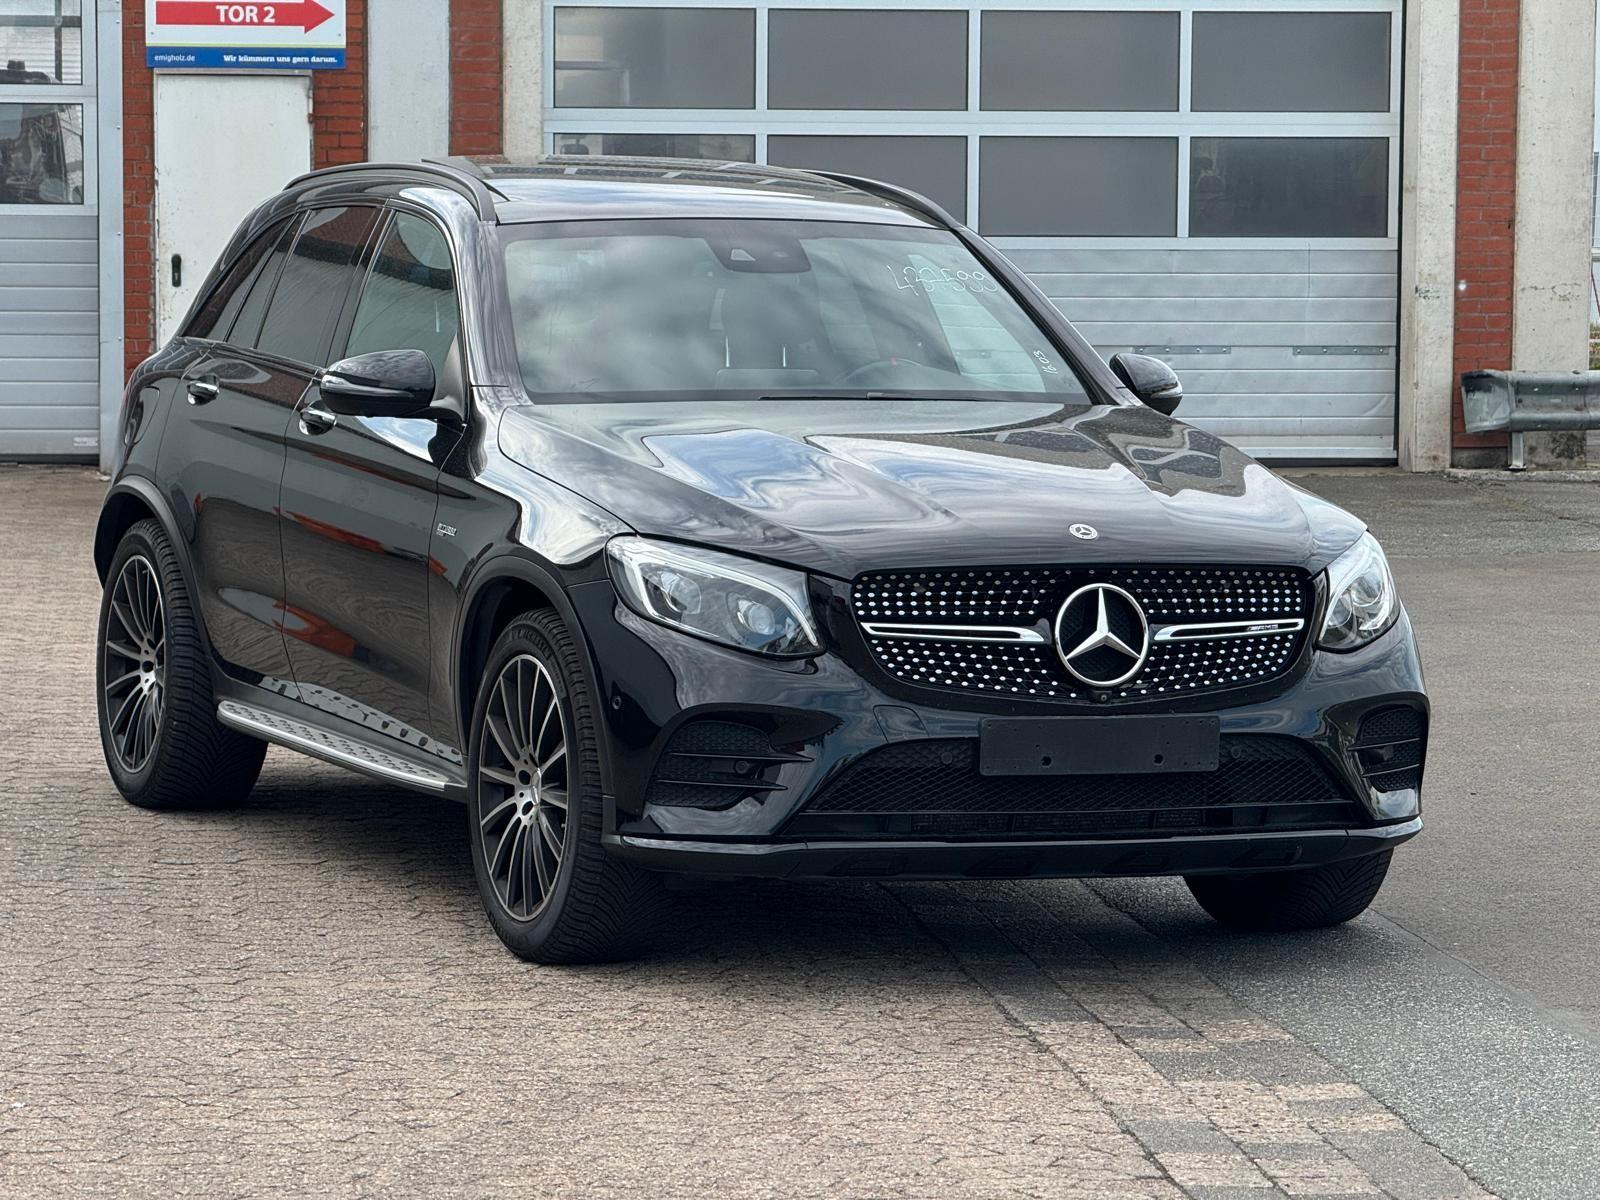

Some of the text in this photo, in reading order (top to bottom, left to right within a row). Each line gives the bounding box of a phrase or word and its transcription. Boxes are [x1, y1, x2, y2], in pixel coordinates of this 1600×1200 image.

[215, 5, 276, 23] TOR 2
[154, 54, 195, 62] emigholz.de
[238, 54, 275, 63] kümmern
[292, 56, 310, 64] gern
[311, 55, 338, 63] darum.
